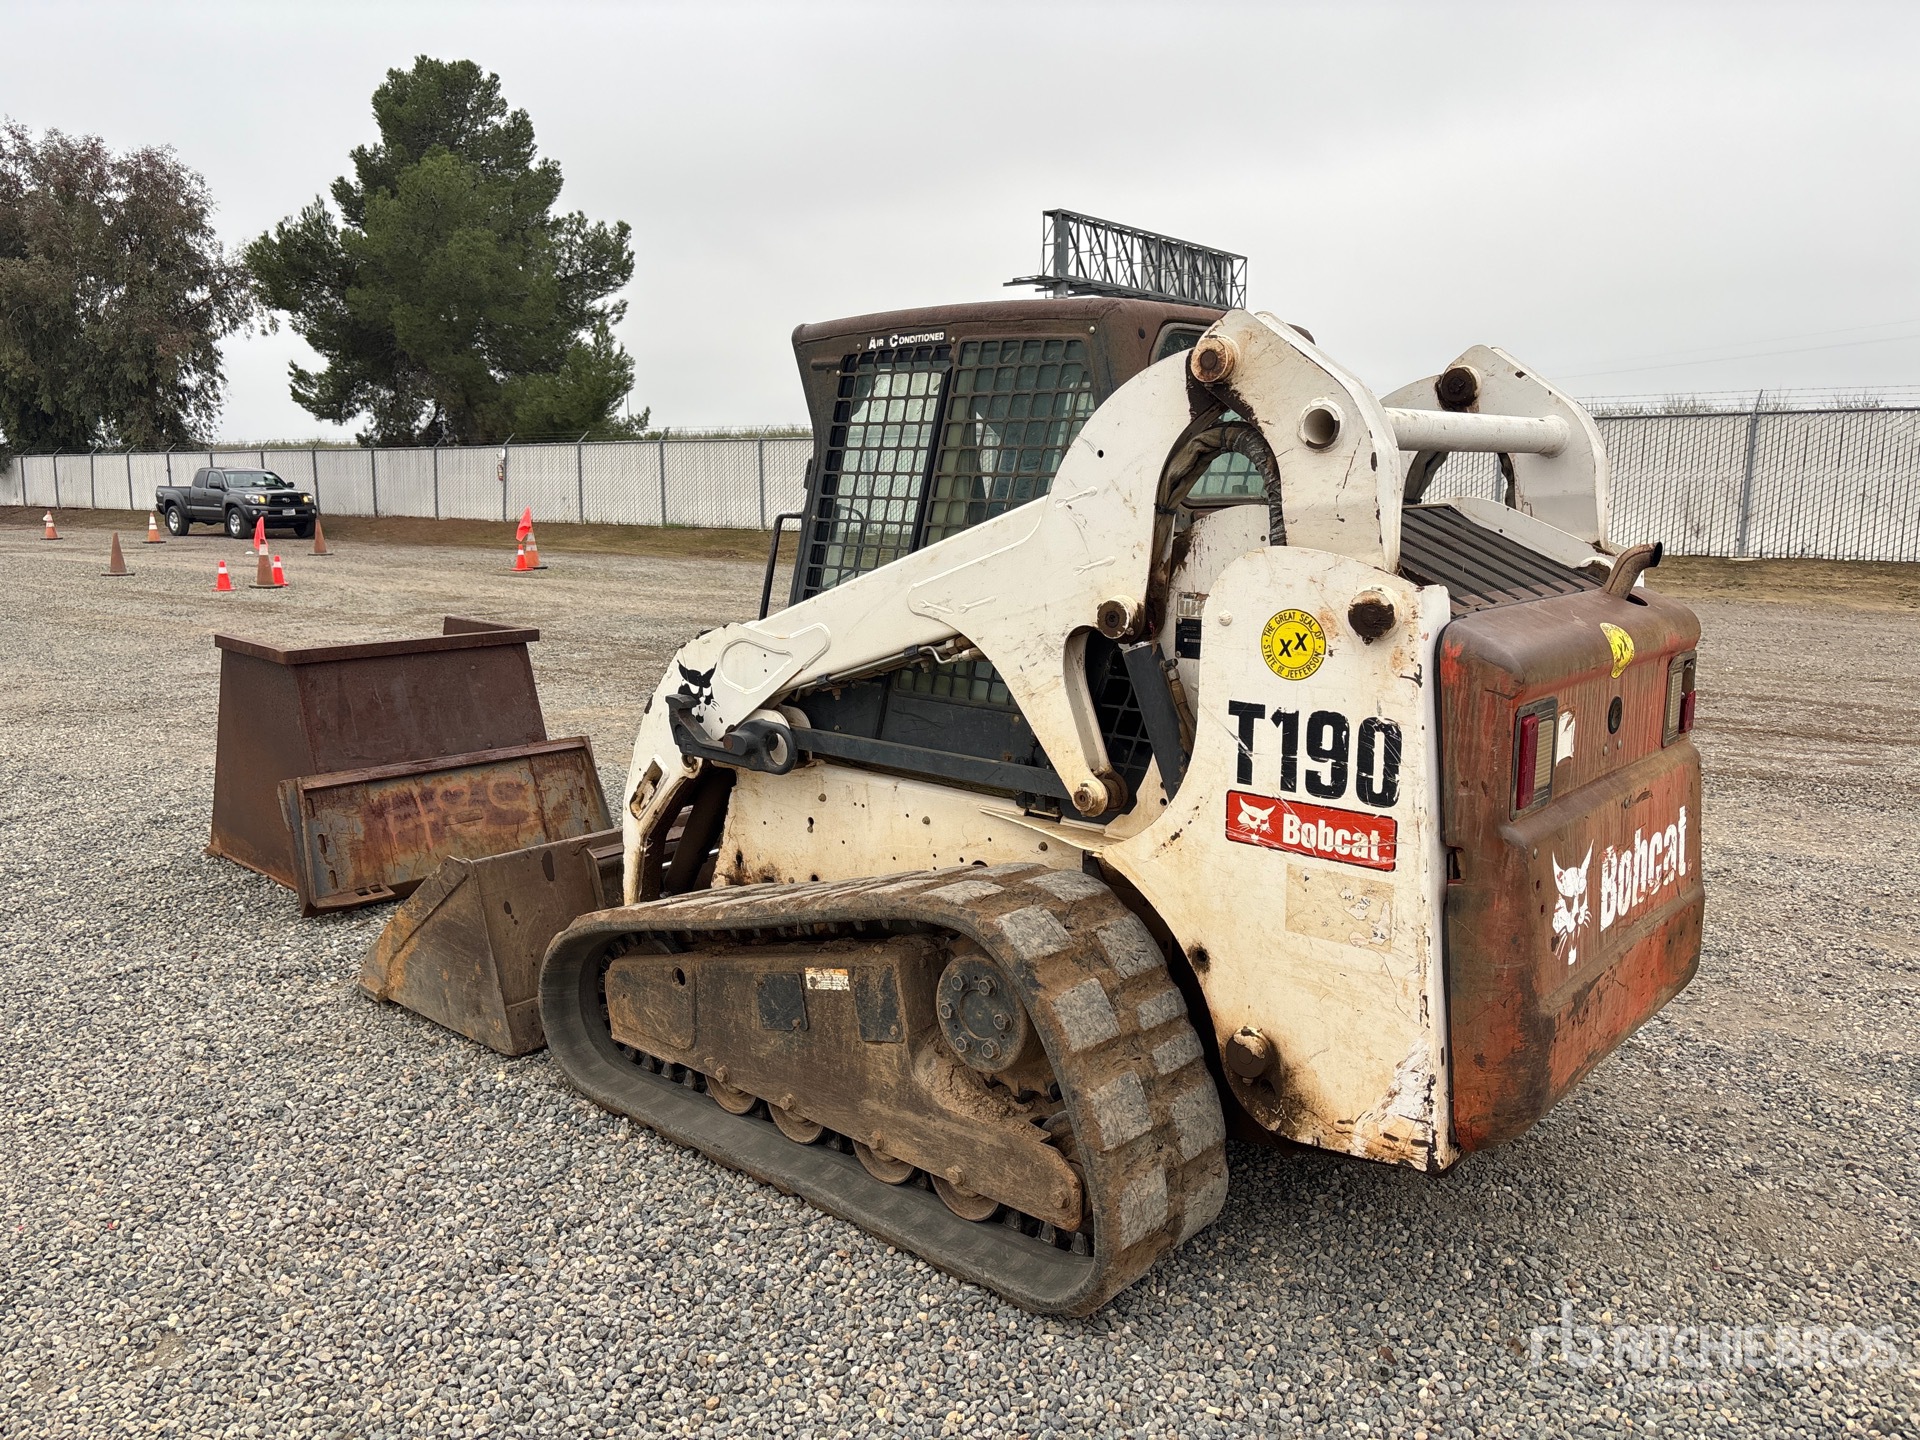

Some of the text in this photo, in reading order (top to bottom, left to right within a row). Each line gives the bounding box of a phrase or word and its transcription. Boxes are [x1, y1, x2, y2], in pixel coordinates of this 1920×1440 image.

[868, 331, 945, 350] AIR CONDITIONED
[1263, 611, 1324, 641] THE GREAT SEAL OF
[1263, 644, 1278, 668] STATE
[1285, 651, 1321, 678] JEFFERSON
[1228, 700, 1402, 809] T190
[1282, 813, 1381, 861] Bobcat
[1600, 805, 1688, 932] Bobcat
